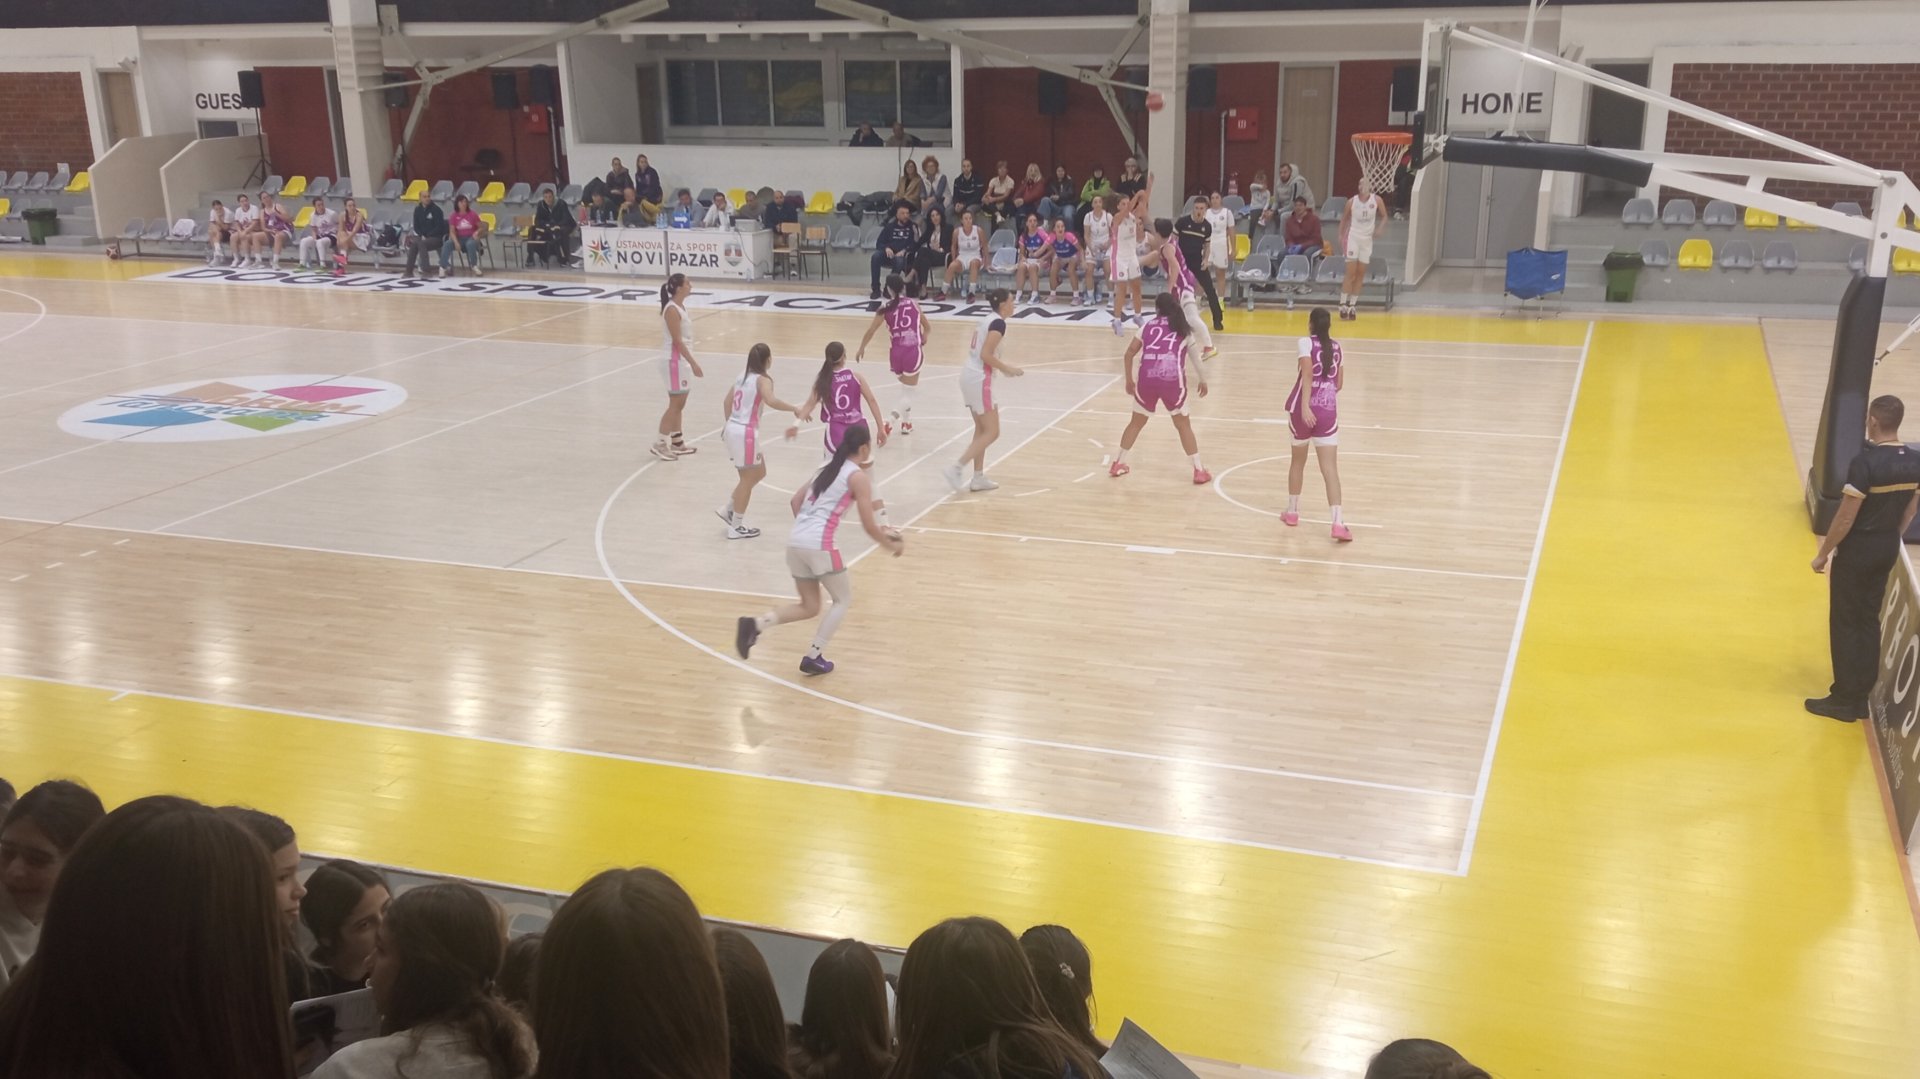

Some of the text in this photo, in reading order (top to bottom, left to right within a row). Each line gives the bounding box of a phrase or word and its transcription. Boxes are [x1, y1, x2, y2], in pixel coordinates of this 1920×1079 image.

[195, 92, 245, 110] GUES
[1461, 92, 1543, 114] HOME
[616, 240, 719, 253] USTANOVA ZA SPORT
[616, 250, 720, 268] NOVI PAZAR
[892, 306, 912, 330] 15
[1145, 326, 1178, 350] 24
[835, 383, 850, 410] 6
